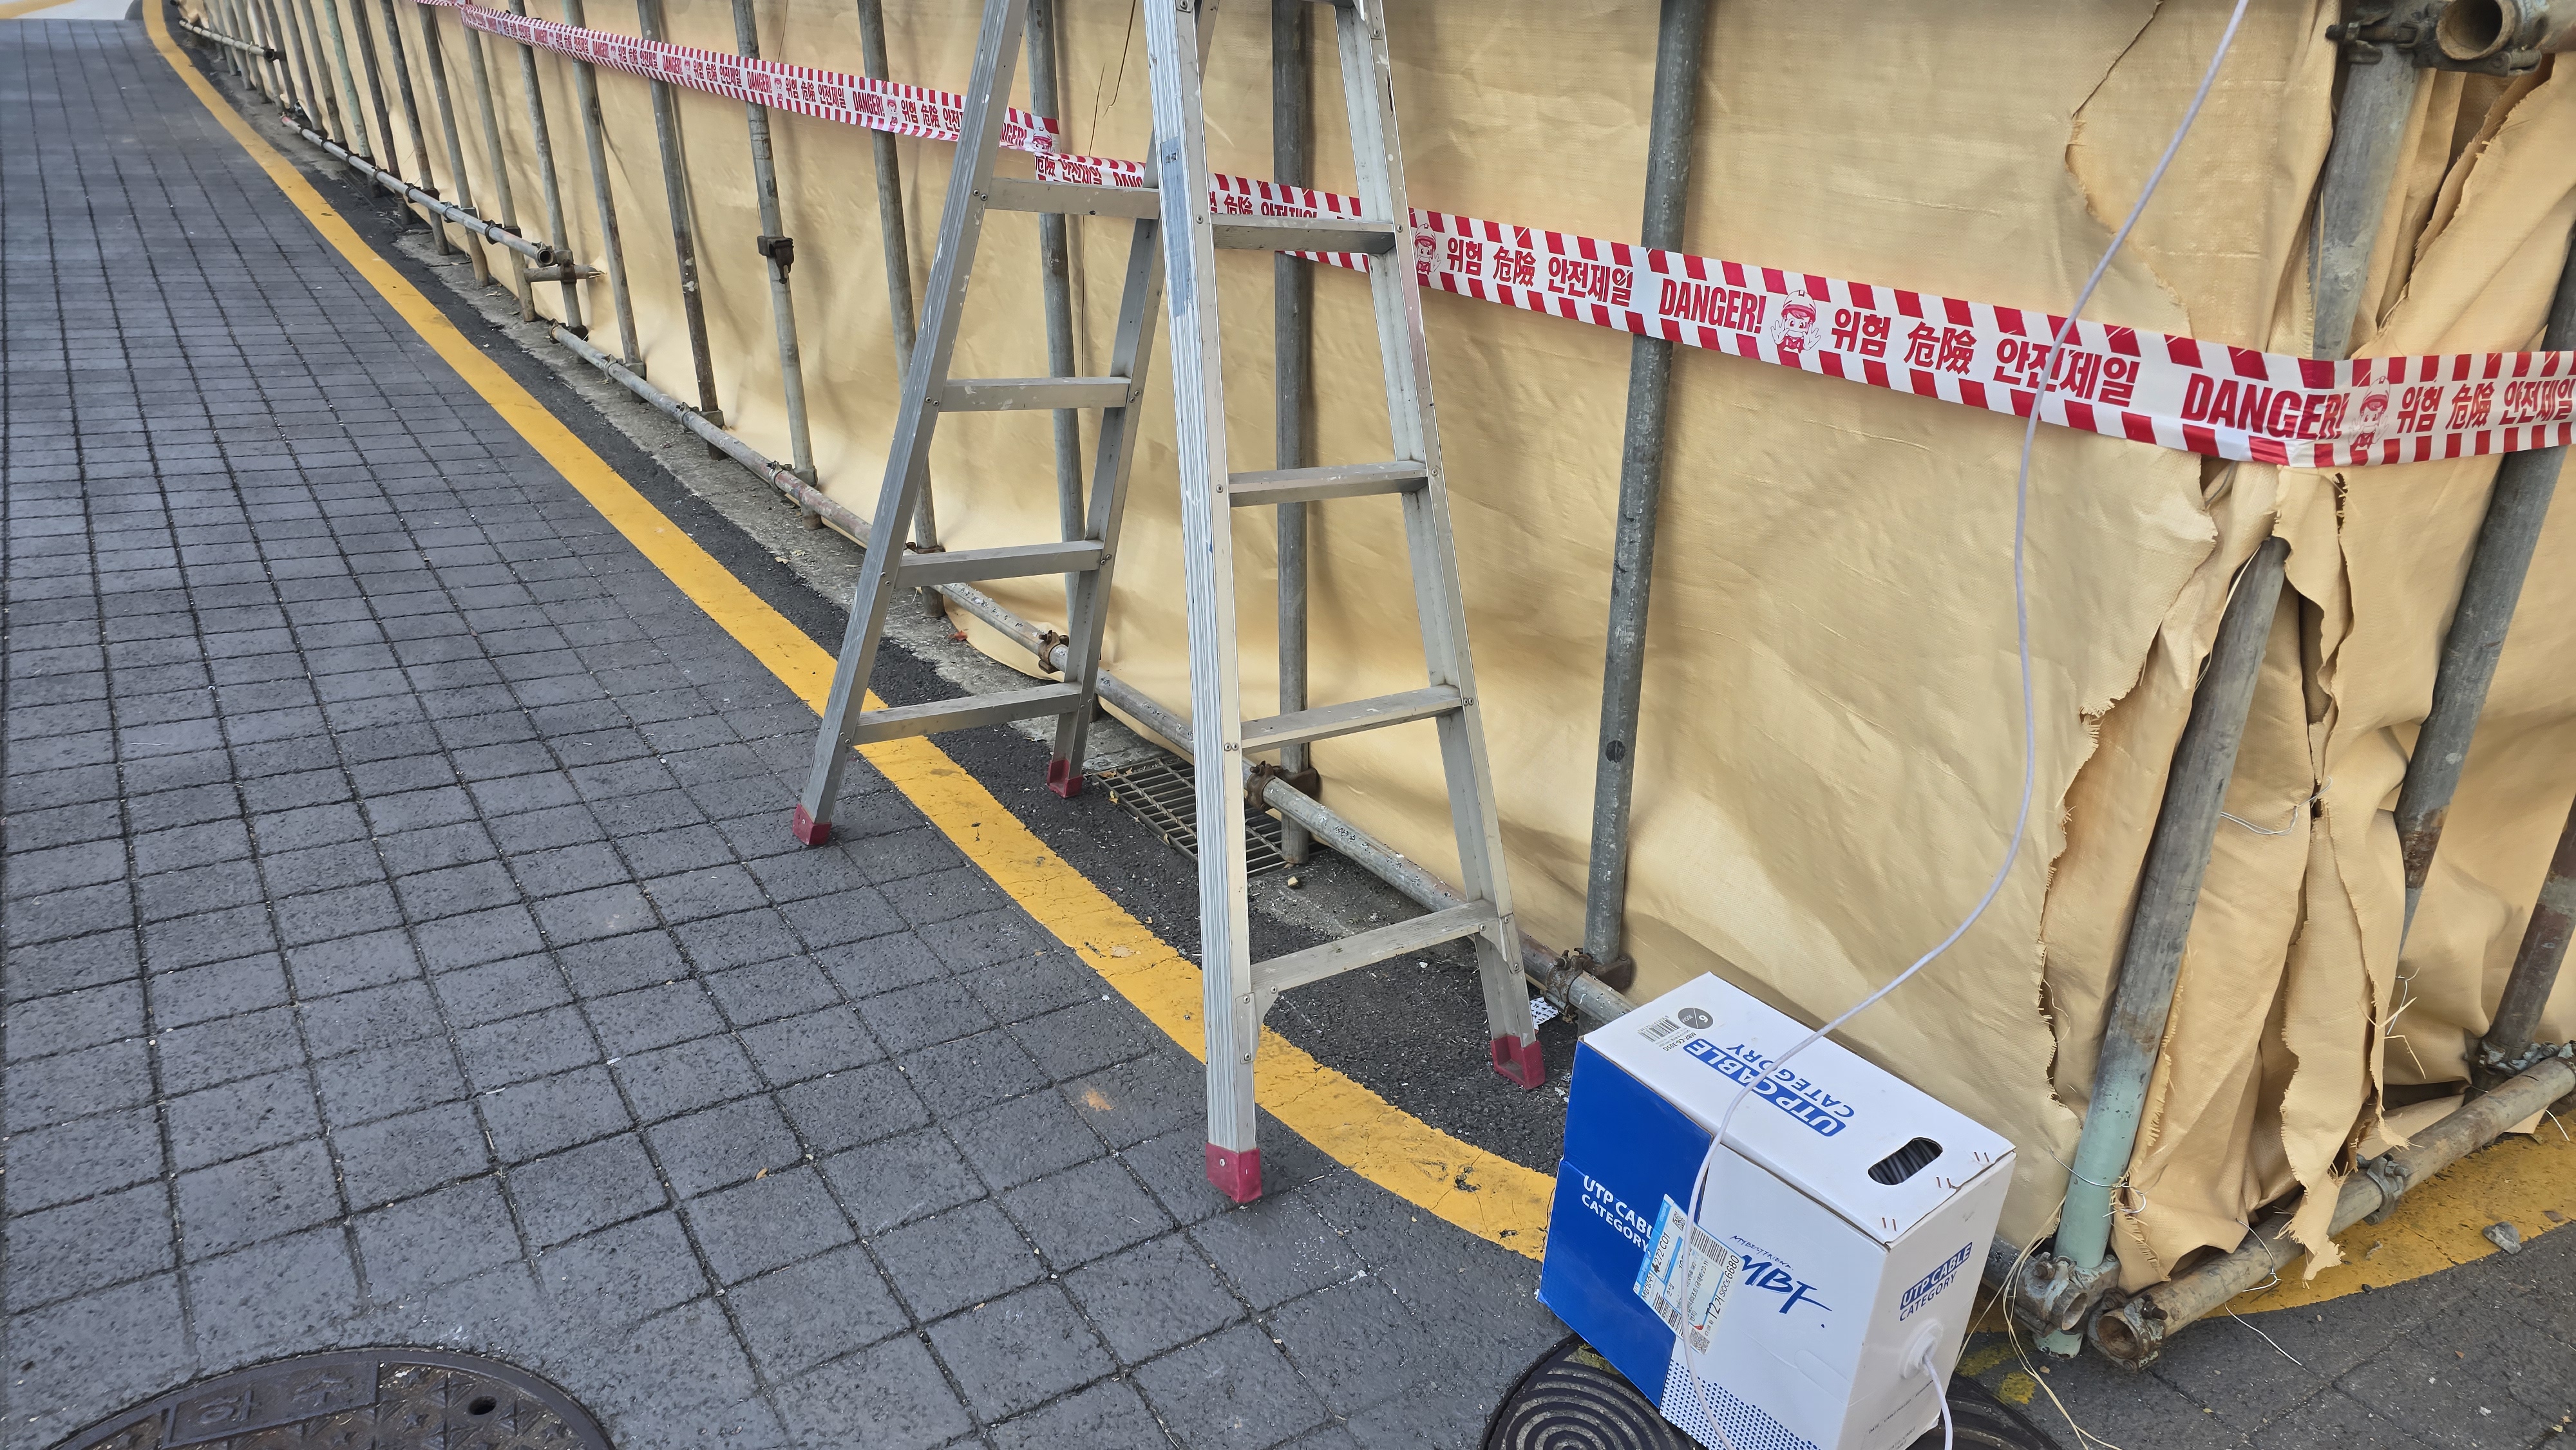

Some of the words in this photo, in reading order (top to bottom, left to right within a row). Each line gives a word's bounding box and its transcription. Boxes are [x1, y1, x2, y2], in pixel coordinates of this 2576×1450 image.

[662, 54, 683, 75] DANGER!
[693, 60, 704, 80] 위험
[719, 65, 743, 88] 안전제일
[746, 71, 772, 93] DANGER!
[785, 77, 798, 99] 위험
[801, 80, 816, 102] 危險
[818, 84, 846, 109] 안전제일
[852, 91, 885, 117] DANGER!
[901, 99, 918, 124] 위험
[921, 103, 941, 129] 危險
[1446, 236, 1483, 278] 위험
[1492, 249, 1537, 287] 危險
[1547, 256, 1633, 308] 안전제일
[1658, 278, 1767, 334] DANGER!
[1831, 308, 1892, 359] 위험
[1903, 321, 1978, 375] 危險
[1993, 337, 2140, 408] 안전제일
[2181, 372, 2347, 441] DANGER!
[2396, 384, 2439, 434] 위험
[2445, 381, 2495, 430] 危險
[2498, 379, 2576, 425] 안전제일
[1686, 1040, 1777, 1095] CABLE
[1726, 1044, 1855, 1118] CATEGORY
[1776, 1097, 1838, 1134] UTP
[1582, 1194, 1649, 1252] CATEGORY
[1584, 1175, 1614, 1204] UTP
[1615, 1201, 1653, 1239] CABL
[1654, 1249, 1665, 1266] 272
[1705, 1301, 1721, 1319] T2
[1724, 1255, 1740, 1279] 6680
[1902, 1277, 1929, 1306] UTP
[1931, 1244, 1971, 1285] CABLE
[1900, 1271, 1957, 1321] CATEGORY
